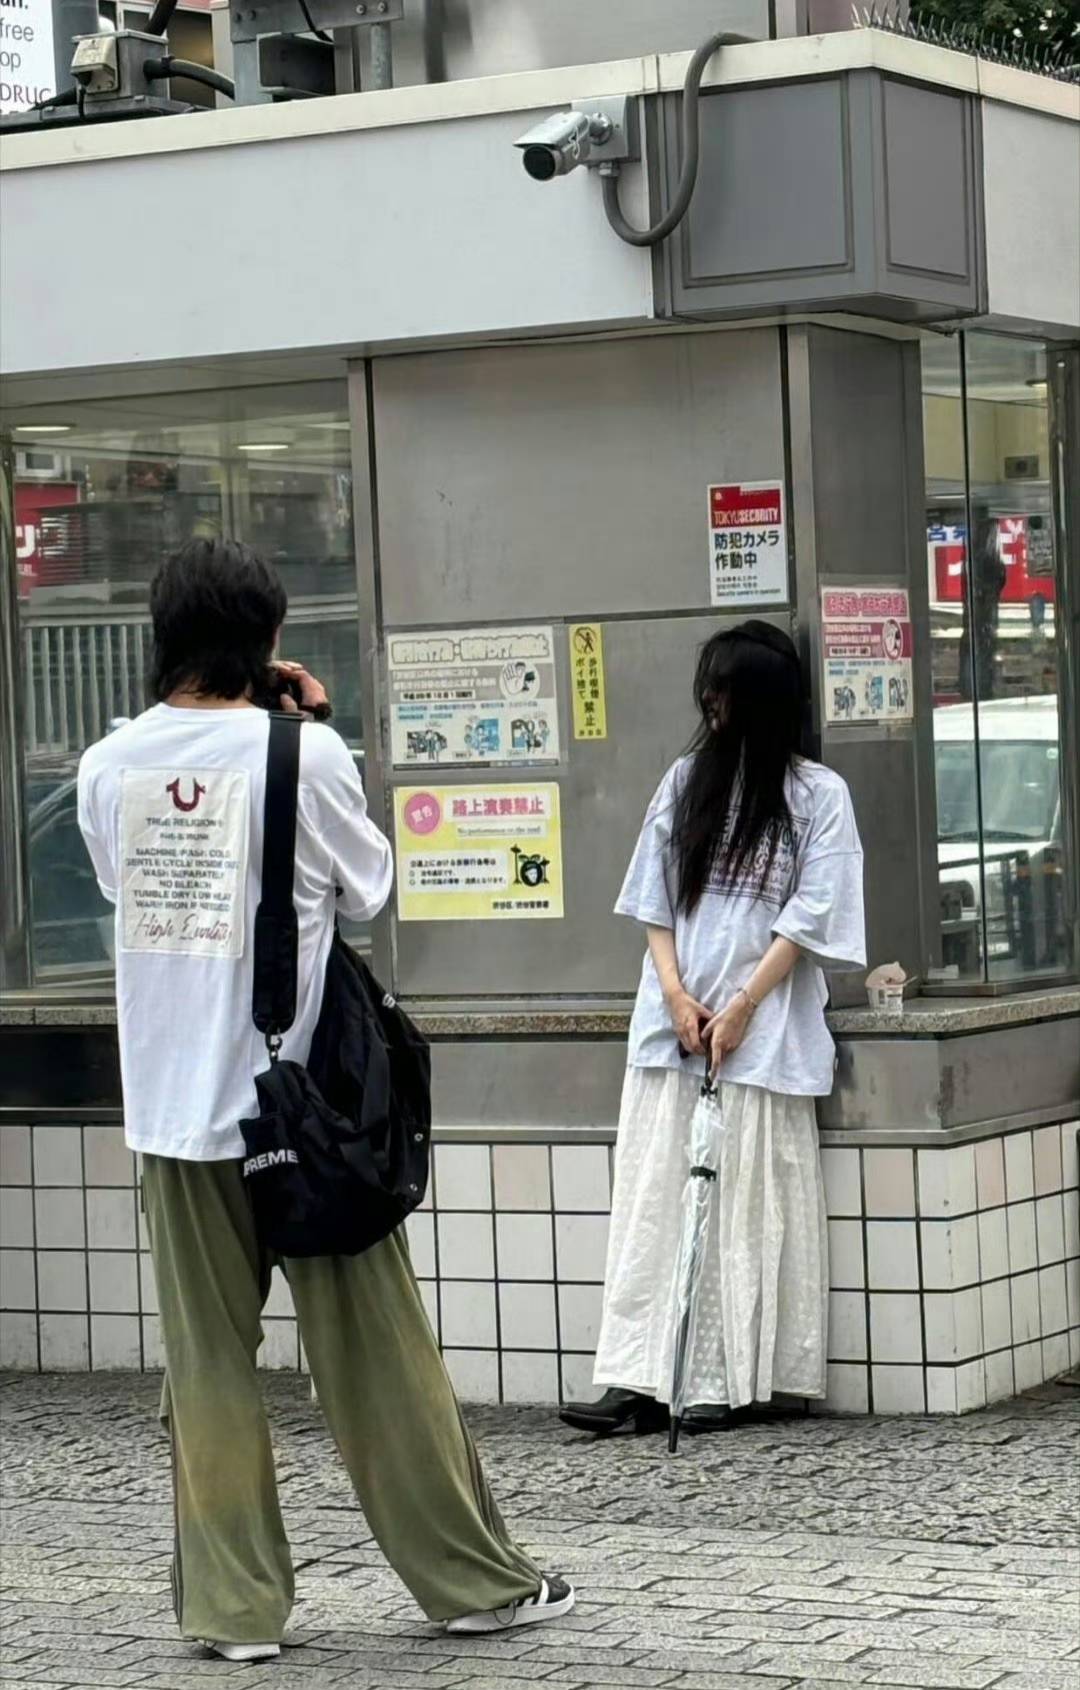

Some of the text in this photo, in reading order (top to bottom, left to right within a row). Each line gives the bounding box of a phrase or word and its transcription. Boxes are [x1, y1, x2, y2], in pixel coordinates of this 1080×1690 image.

[714, 530, 780, 549] 防犯カメラ
[715, 551, 757, 570] 作動中
[583, 701, 597, 726] 禁止
